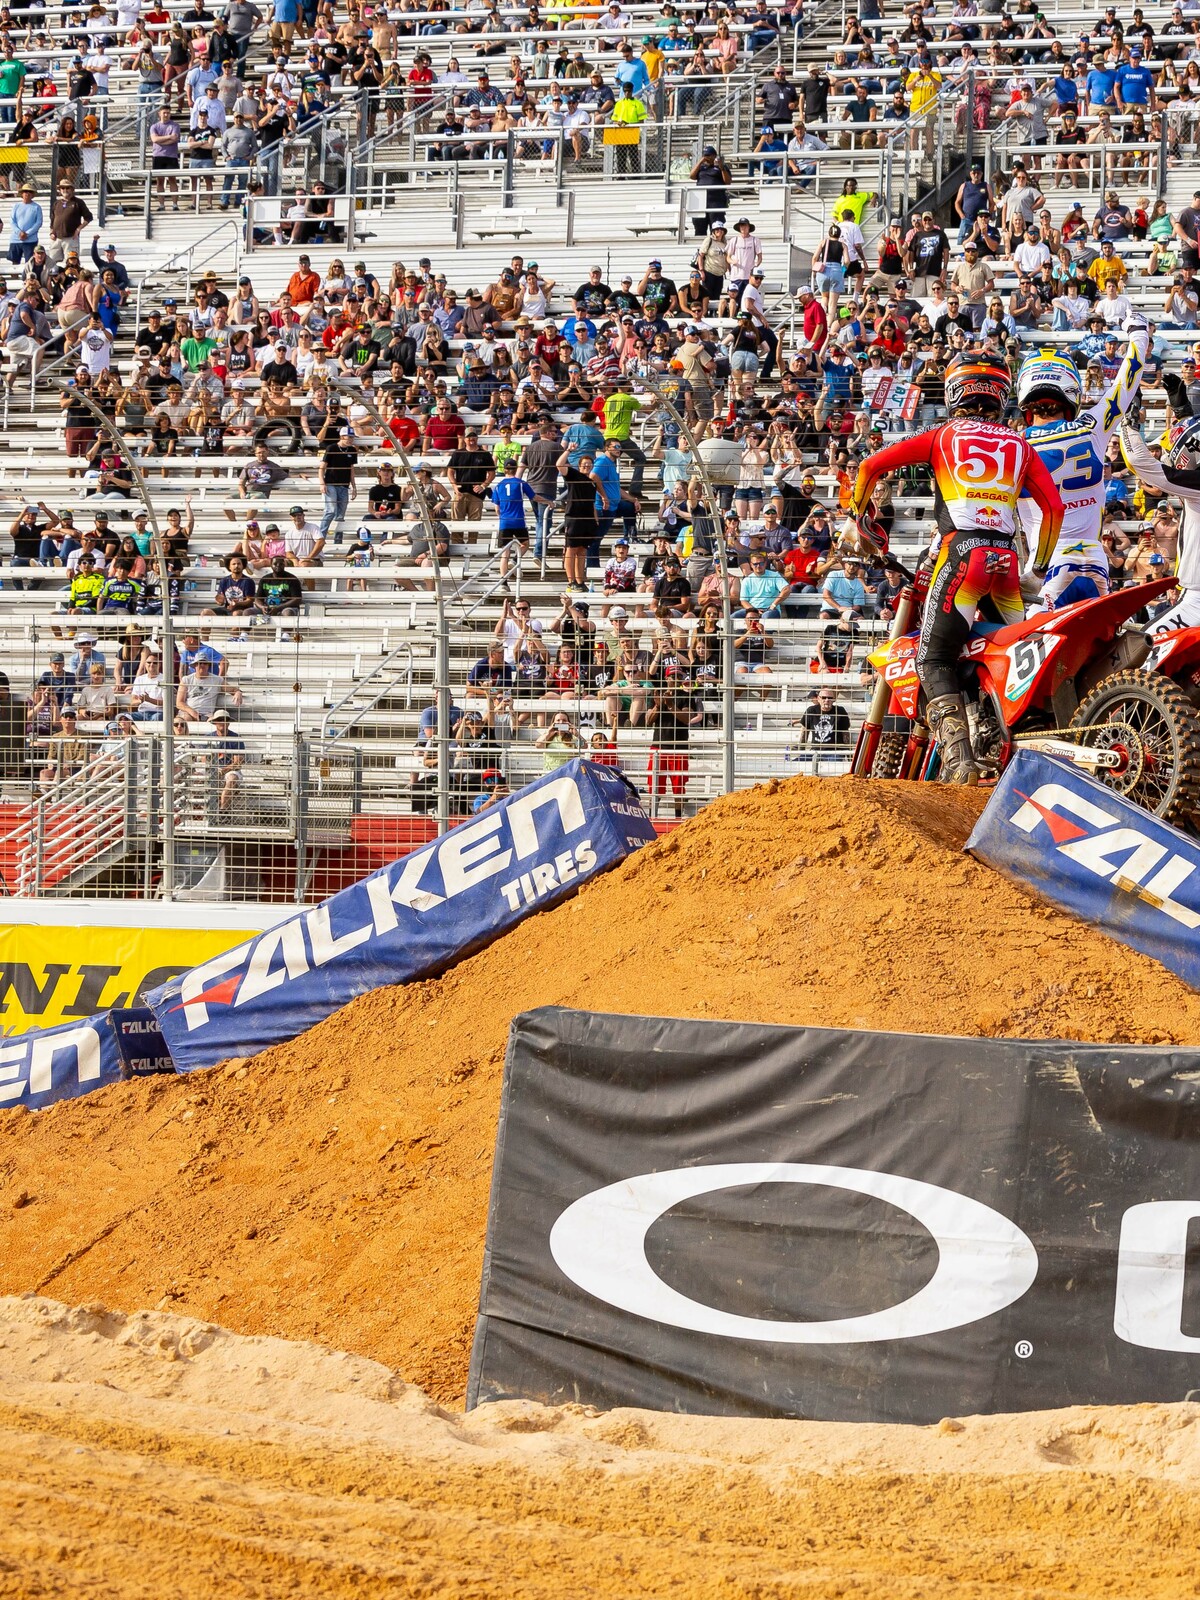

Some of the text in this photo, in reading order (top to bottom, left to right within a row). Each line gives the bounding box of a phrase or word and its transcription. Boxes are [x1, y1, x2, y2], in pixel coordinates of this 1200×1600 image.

[1031, 374, 1063, 382] CHASE
[966, 382, 999, 394] JUSTIN
[956, 437, 1018, 490] 51
[1018, 441, 1104, 498] 23
[505, 484, 511, 497] 1
[966, 491, 1009, 502] GASGAS
[975, 517, 990, 526] Red
[942, 561, 968, 614] GASGAS
[1013, 634, 1046, 681] 51
[609, 802, 651, 819] FALKEN
[501, 840, 598, 912] TIRES
[169, 776, 587, 1031] FALKEN
[122, 1021, 162, 1034] FALKE
[131, 1057, 175, 1071] FALKE
